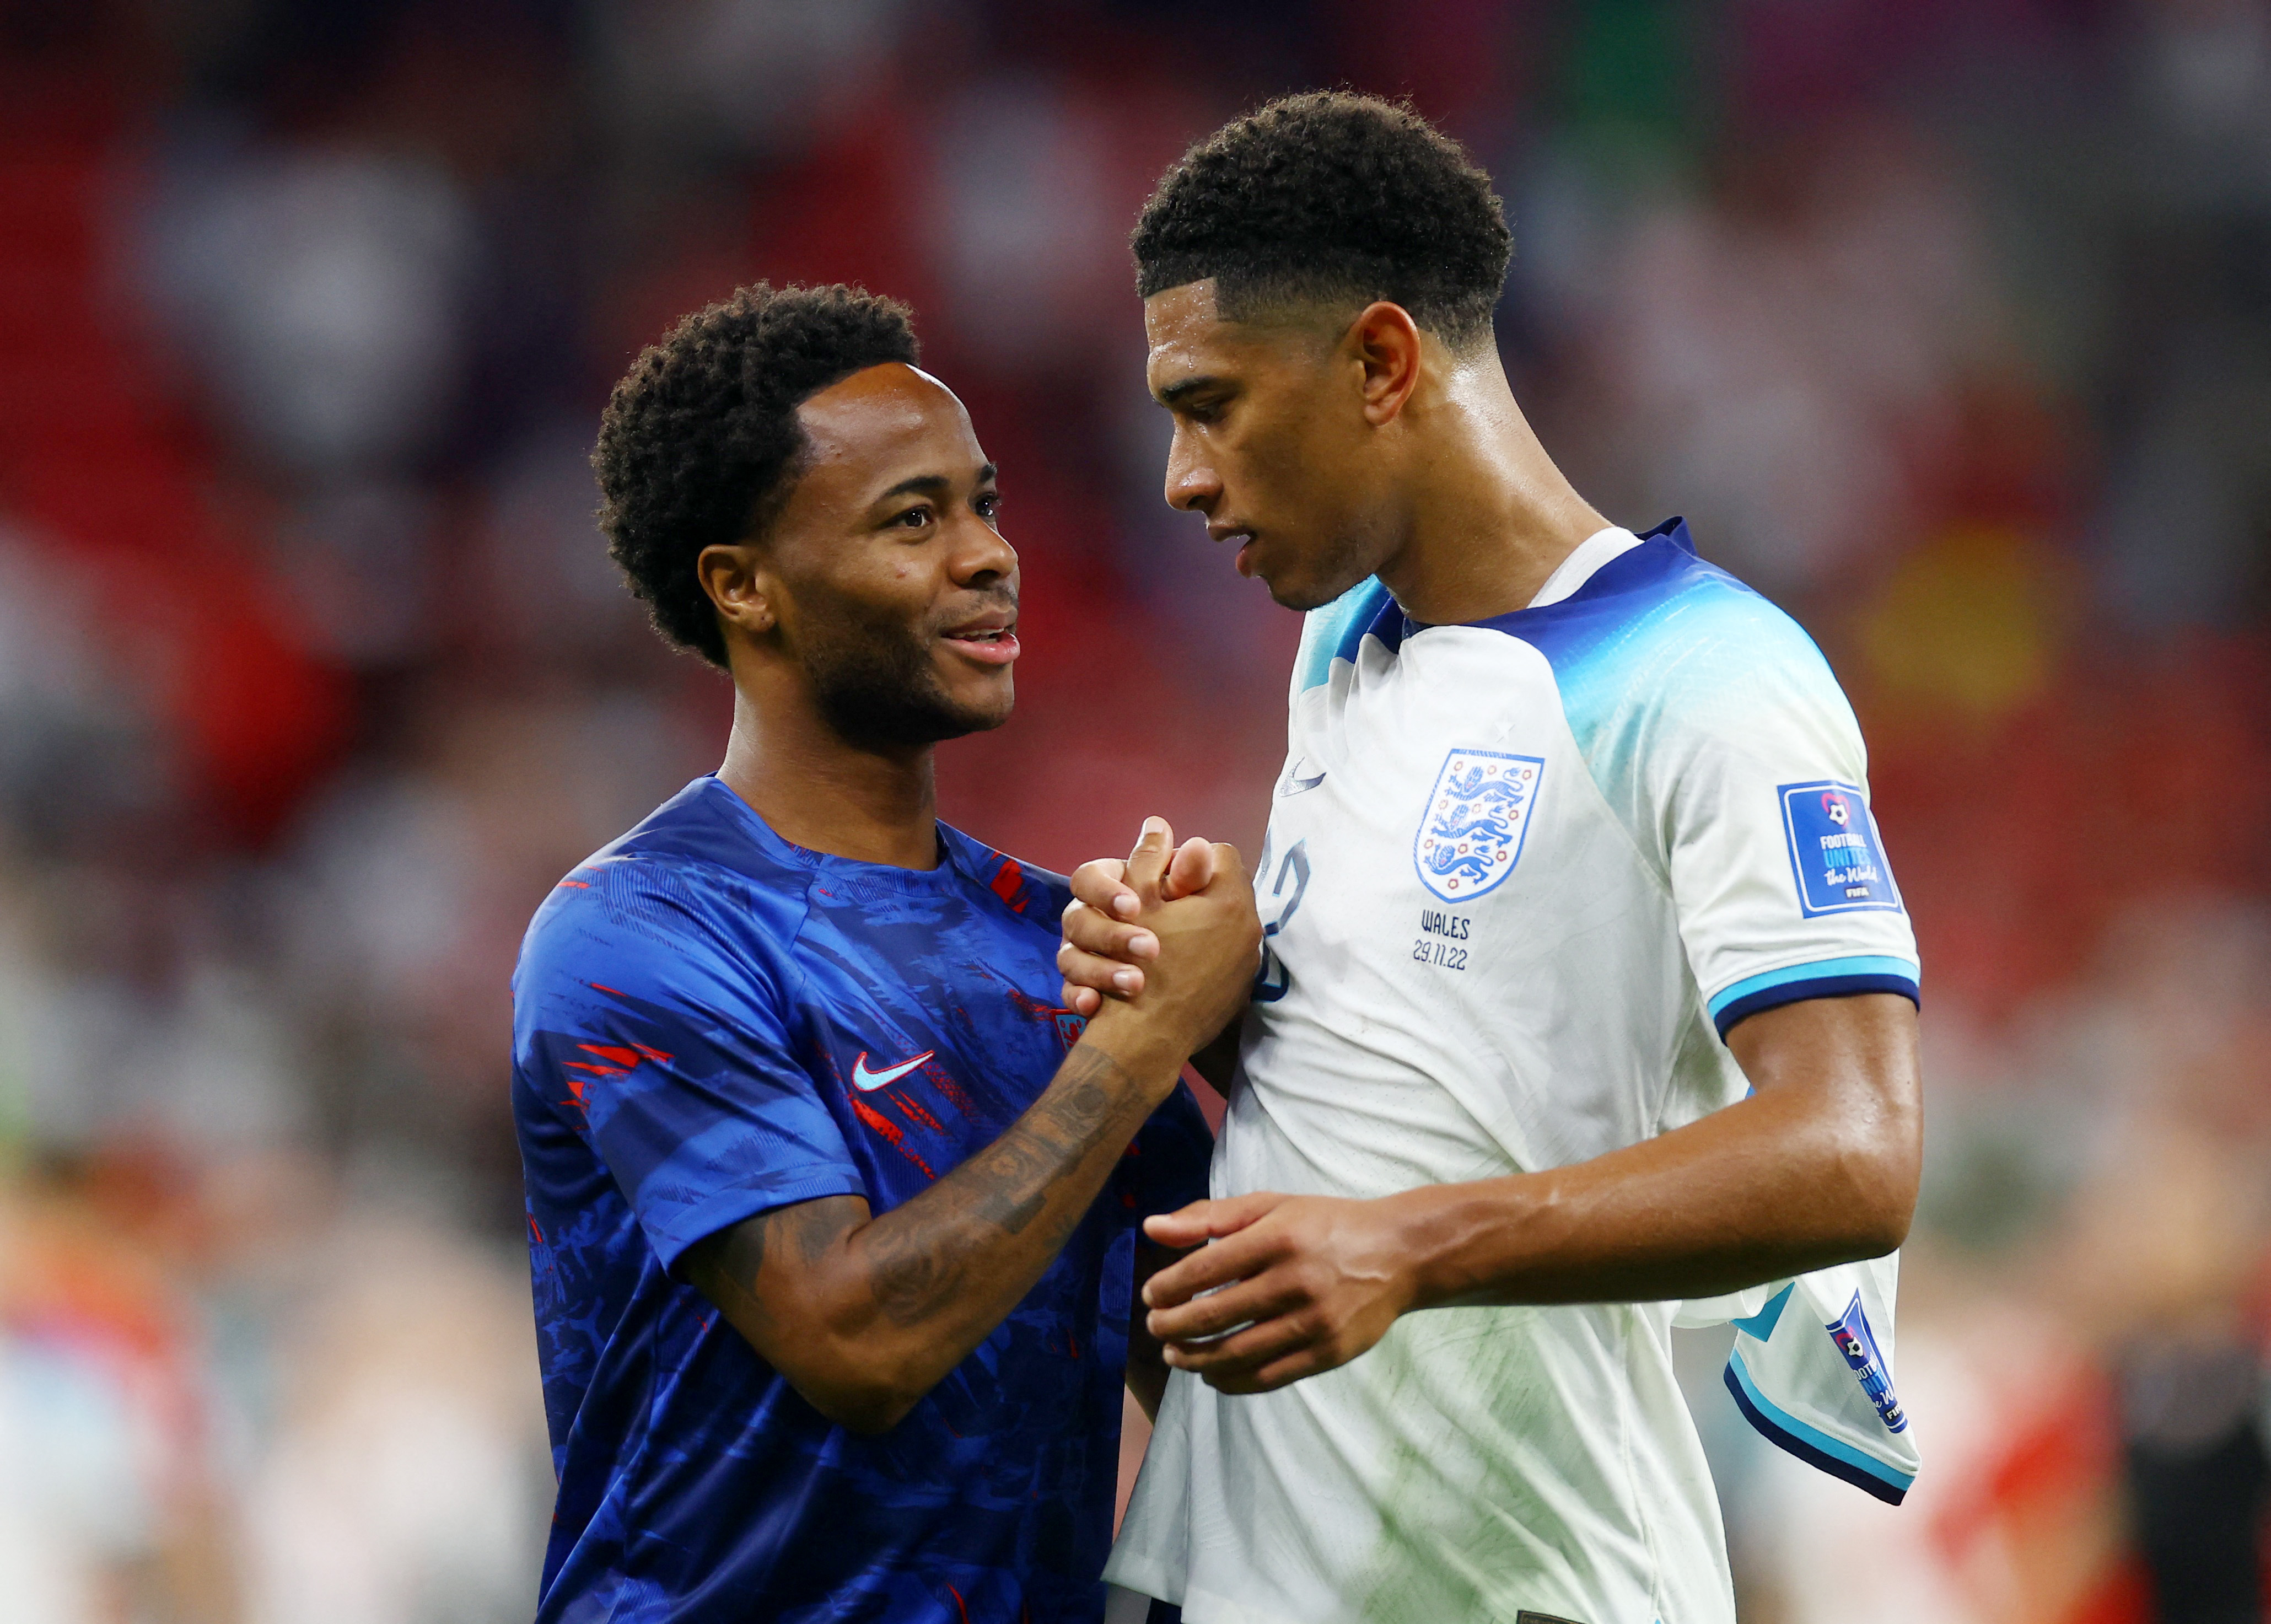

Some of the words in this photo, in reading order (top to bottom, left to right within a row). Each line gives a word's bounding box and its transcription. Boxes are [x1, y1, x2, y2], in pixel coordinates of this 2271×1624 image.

[1820, 833, 1867, 849] FOOTBALL
[1823, 847, 1872, 868] UNITES
[1824, 868, 1847, 886] the
[1845, 865, 1879, 883] World
[1845, 887, 1870, 898] FIFA
[1250, 825, 1310, 1002] 2
[1422, 909, 1470, 940] WALES
[1413, 939, 1467, 970] 29.11.22
